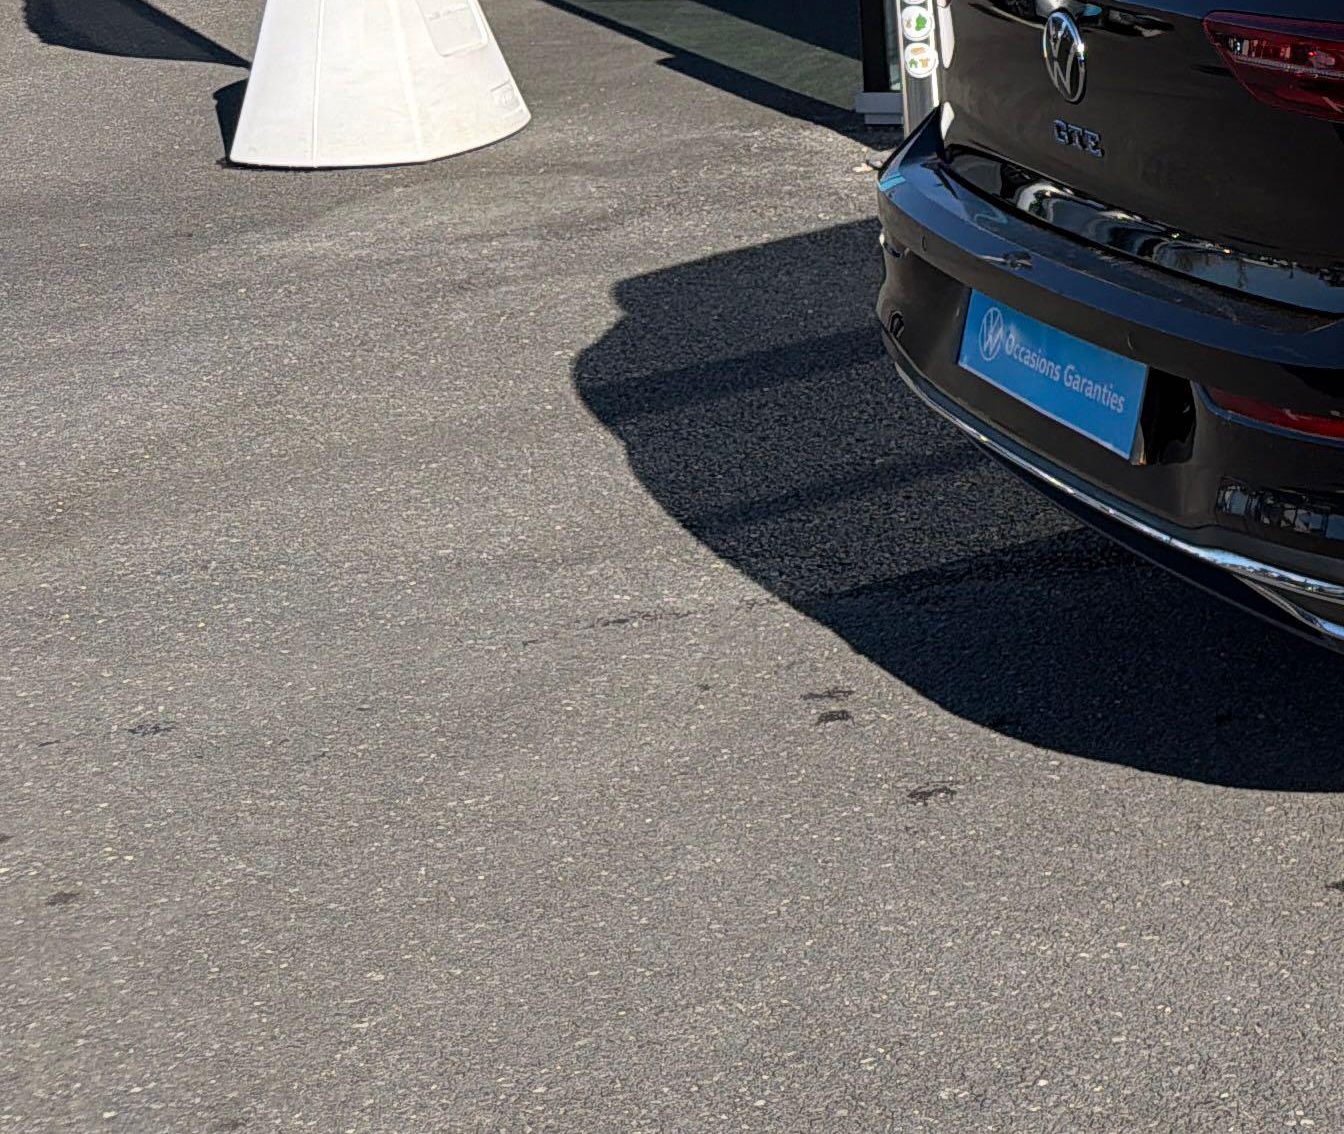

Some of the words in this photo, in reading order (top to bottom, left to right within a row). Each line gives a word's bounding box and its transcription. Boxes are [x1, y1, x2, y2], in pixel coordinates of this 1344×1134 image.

[1054, 119, 1105, 158] GTE
[1004, 331, 1061, 383] Occasions
[1063, 364, 1126, 414] Garanties
